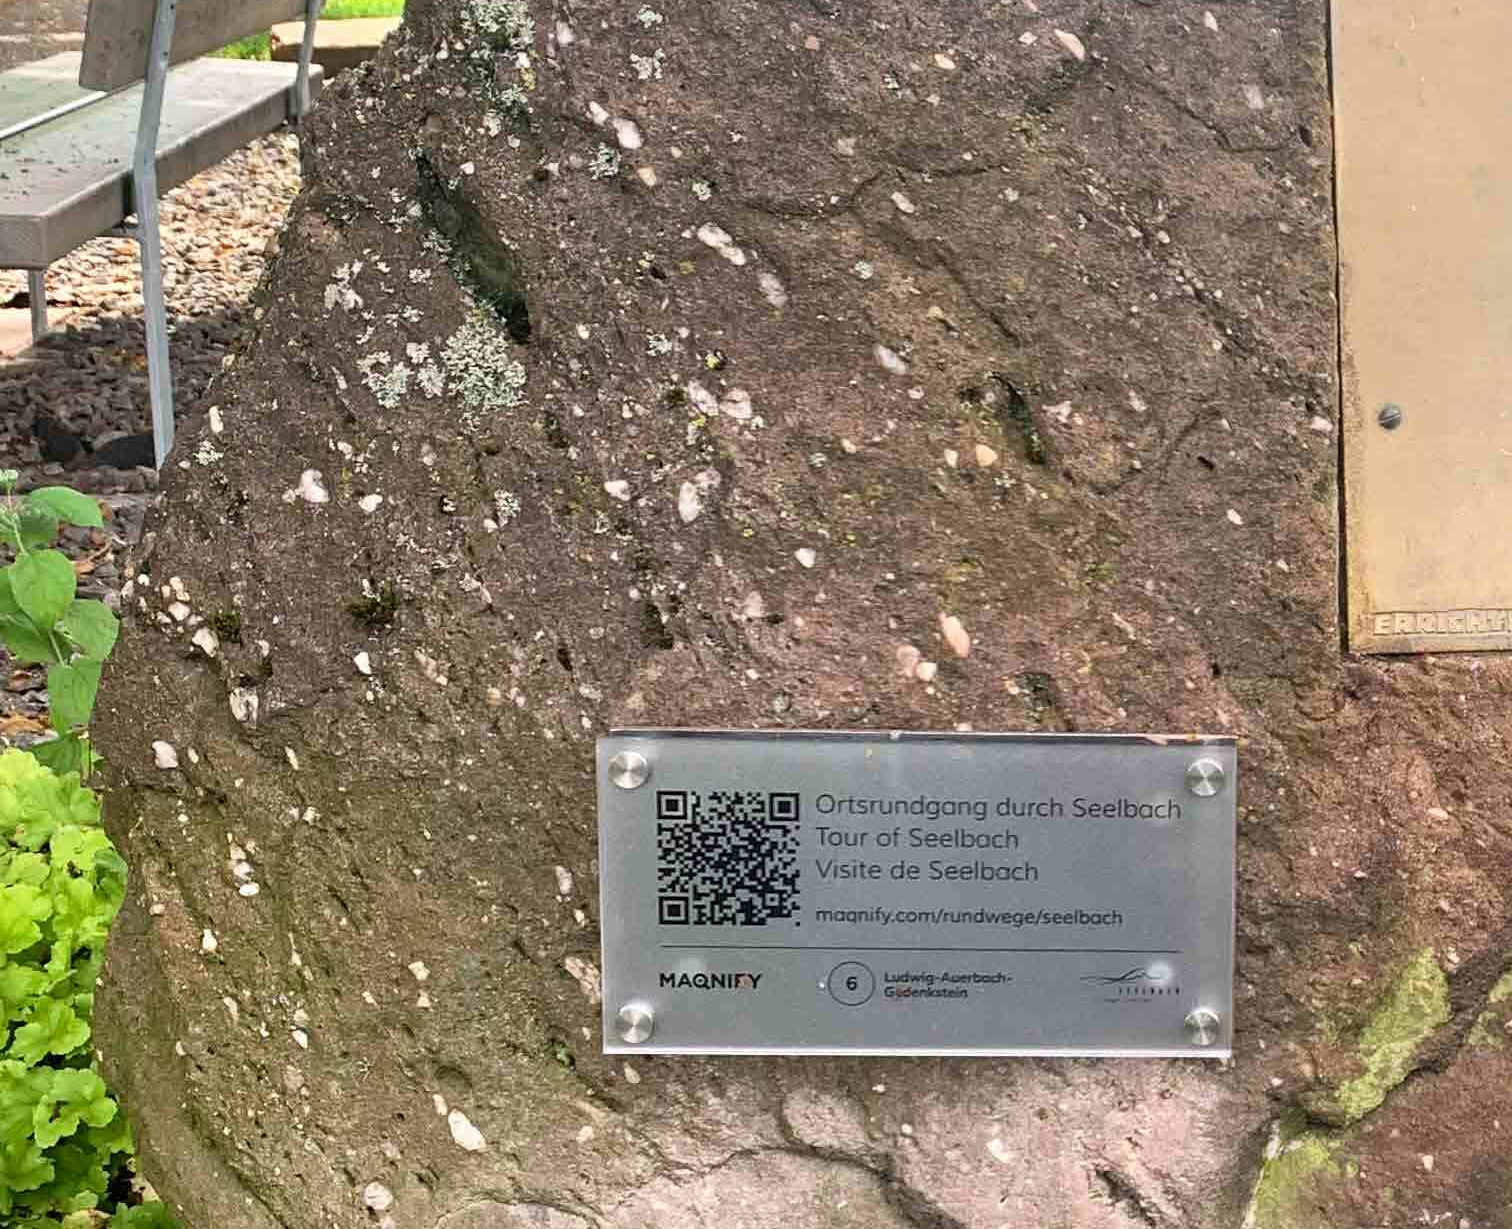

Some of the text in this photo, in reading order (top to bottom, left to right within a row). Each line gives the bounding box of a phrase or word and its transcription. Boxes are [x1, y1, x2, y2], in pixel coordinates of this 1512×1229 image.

[815, 793, 1182, 821] Ortsrundgang durch Seelbach
[815, 826, 1019, 849] Tour of Seelbach
[815, 858, 1039, 881] Visite de Seelbach
[815, 906, 1123, 928] maqnify.com/rundwege/seelbach
[659, 972, 762, 989] MAQNIFY
[845, 976, 858, 991] 6
